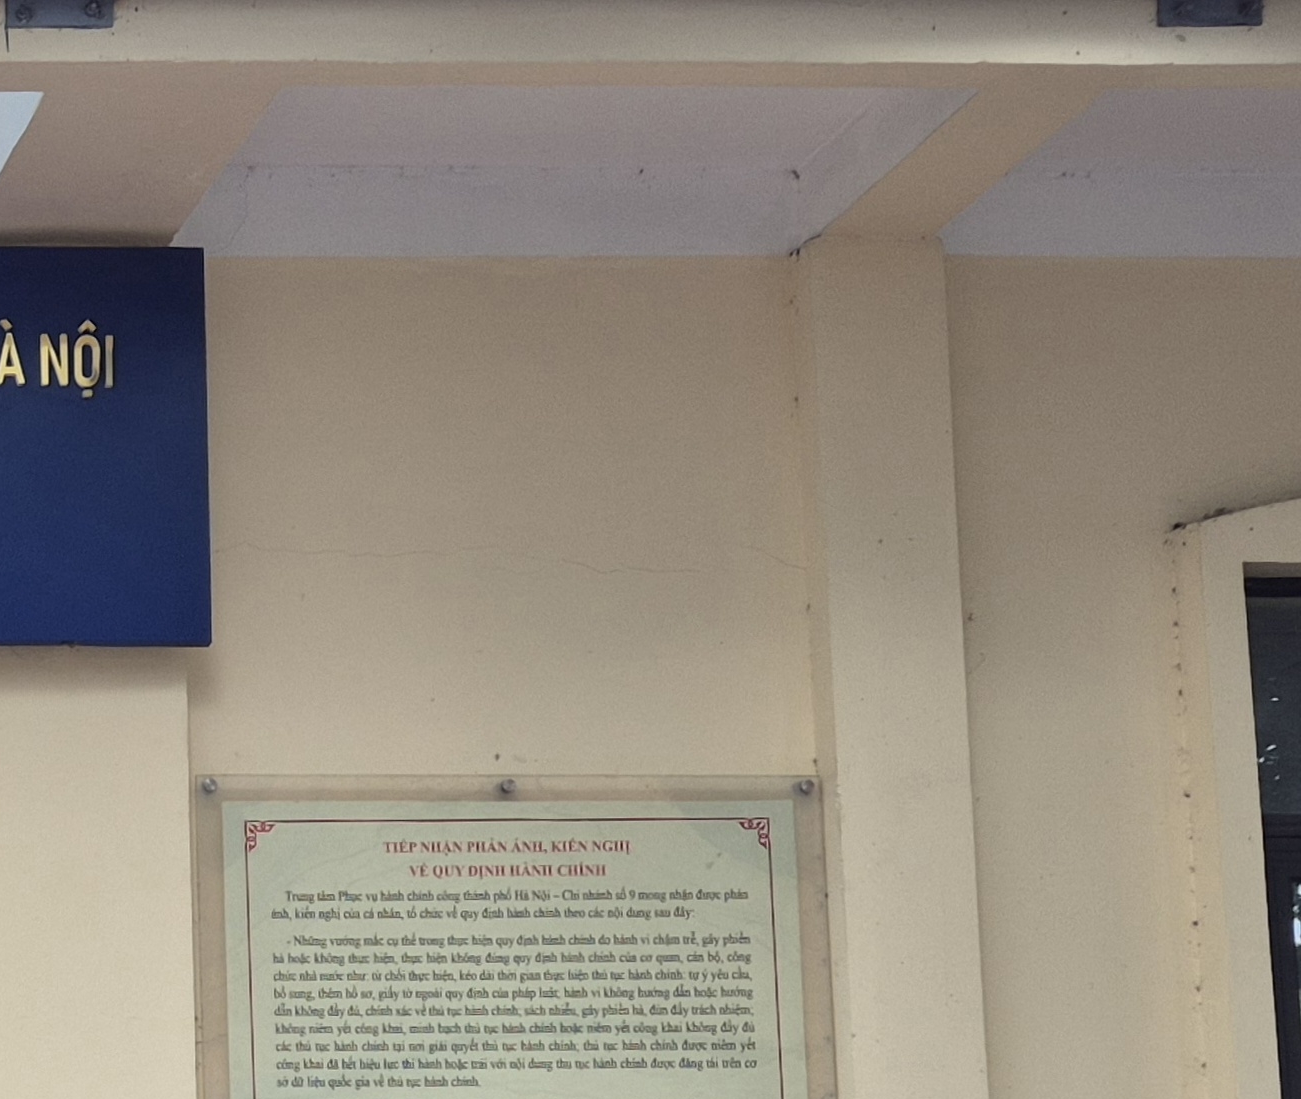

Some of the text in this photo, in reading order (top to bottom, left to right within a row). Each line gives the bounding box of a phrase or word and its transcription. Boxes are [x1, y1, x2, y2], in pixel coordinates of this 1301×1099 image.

[39, 322, 114, 397] NỘI
[383, 839, 417, 853] TIẾP
[420, 840, 462, 856] NHẬN
[511, 838, 547, 853] ÁNH,
[592, 840, 629, 854] NGHỊ
[432, 865, 464, 879] QUY
[468, 865, 505, 879] ĐỊNH
[510, 862, 552, 876] HÀNH
[557, 862, 605, 876] CHÍNH
